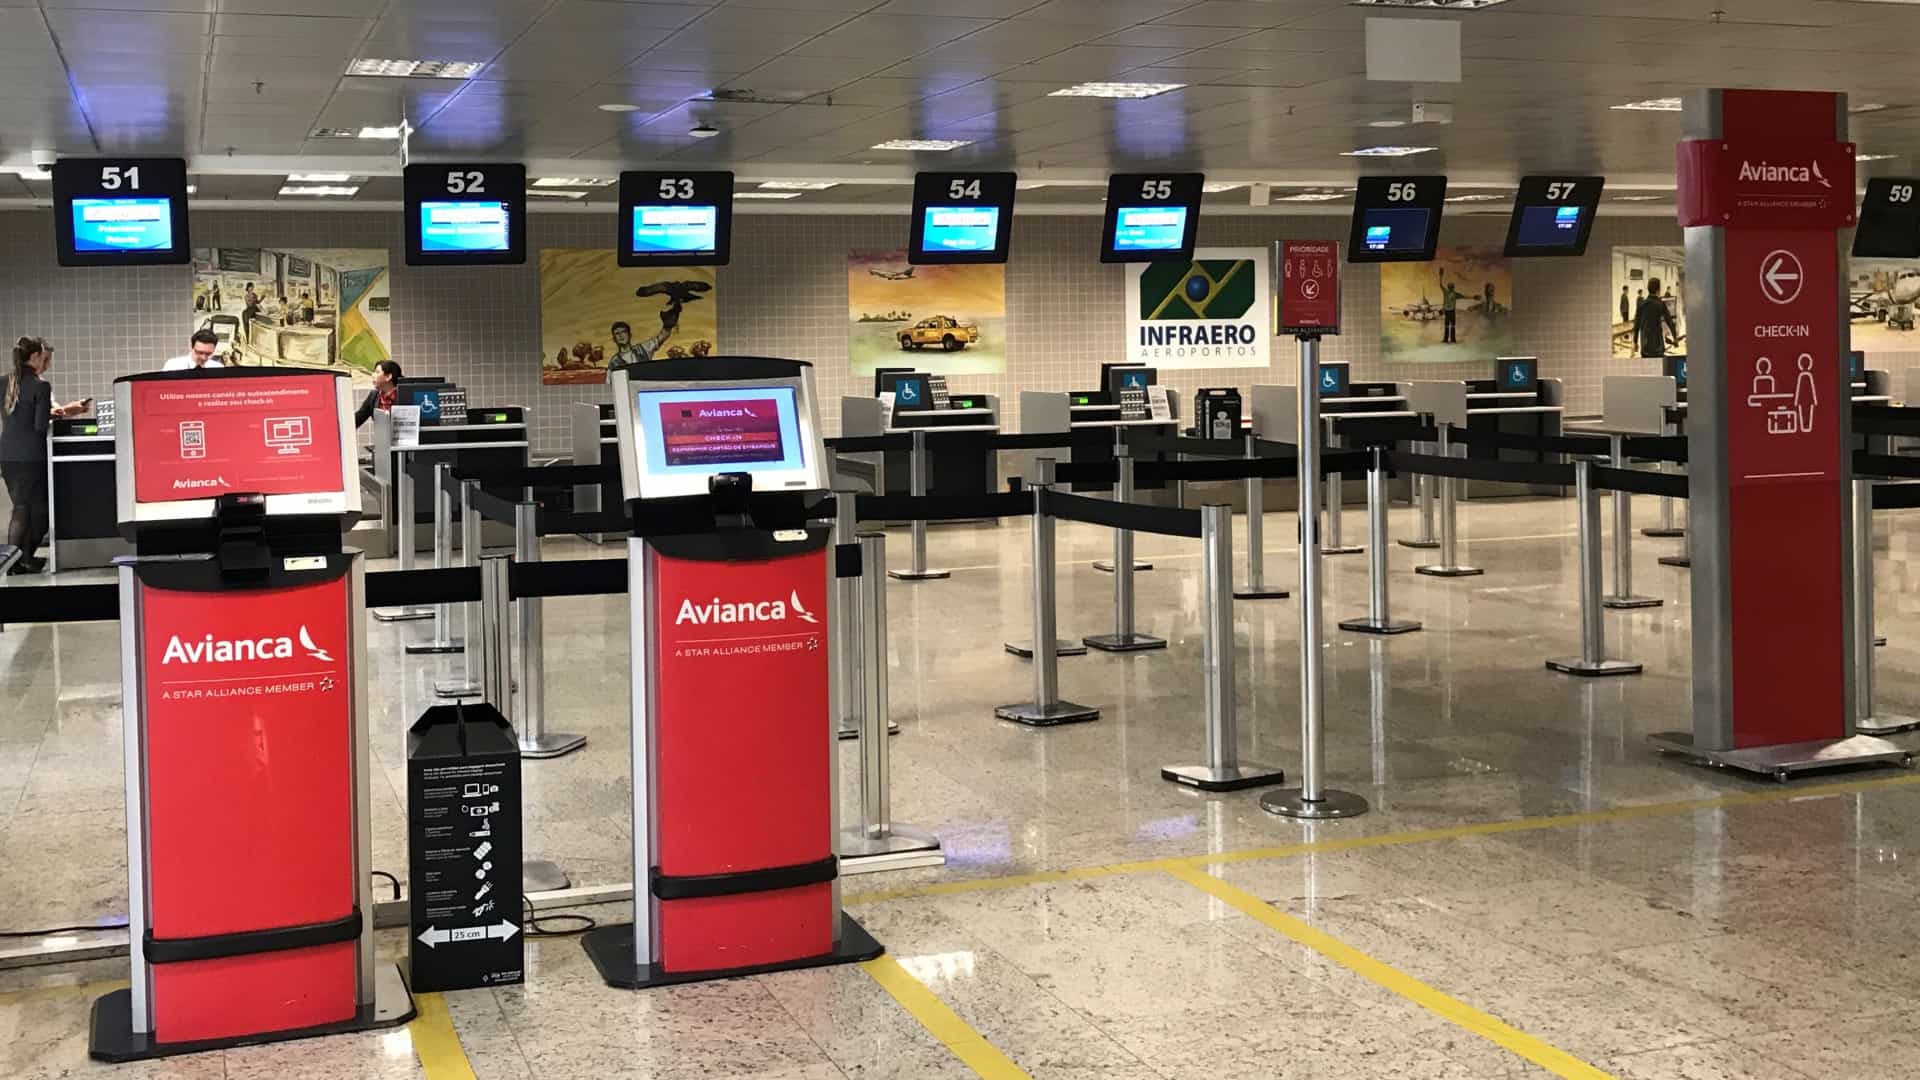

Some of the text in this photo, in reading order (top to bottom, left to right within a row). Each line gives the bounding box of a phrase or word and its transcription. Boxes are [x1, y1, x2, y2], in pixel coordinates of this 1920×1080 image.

[101, 166, 139, 190] 51
[1738, 160, 1809, 182] Avianca
[446, 171, 485, 193] 52
[658, 178, 695, 199] 53
[948, 179, 981, 199] 54
[1141, 180, 1172, 199] 55
[1387, 182, 1416, 201] 56
[1546, 182, 1576, 200] 57
[1888, 184, 1913, 202] 59
[1140, 324, 1256, 346] INFRAERO
[1754, 324, 1809, 338] CHECK-IN
[1141, 346, 1257, 357] AEROPORTOS
[699, 407, 743, 418] Avianca
[172, 477, 218, 489] Avianca
[675, 597, 786, 625] Avianca
[162, 634, 293, 664] Avianca
[685, 648, 710, 657] STAR
[713, 645, 761, 656] ALLIANCE
[763, 641, 803, 652] MEMBER
[162, 682, 315, 700] A STAR ALLIANCE MEMBER
[455, 931, 465, 939] 25
